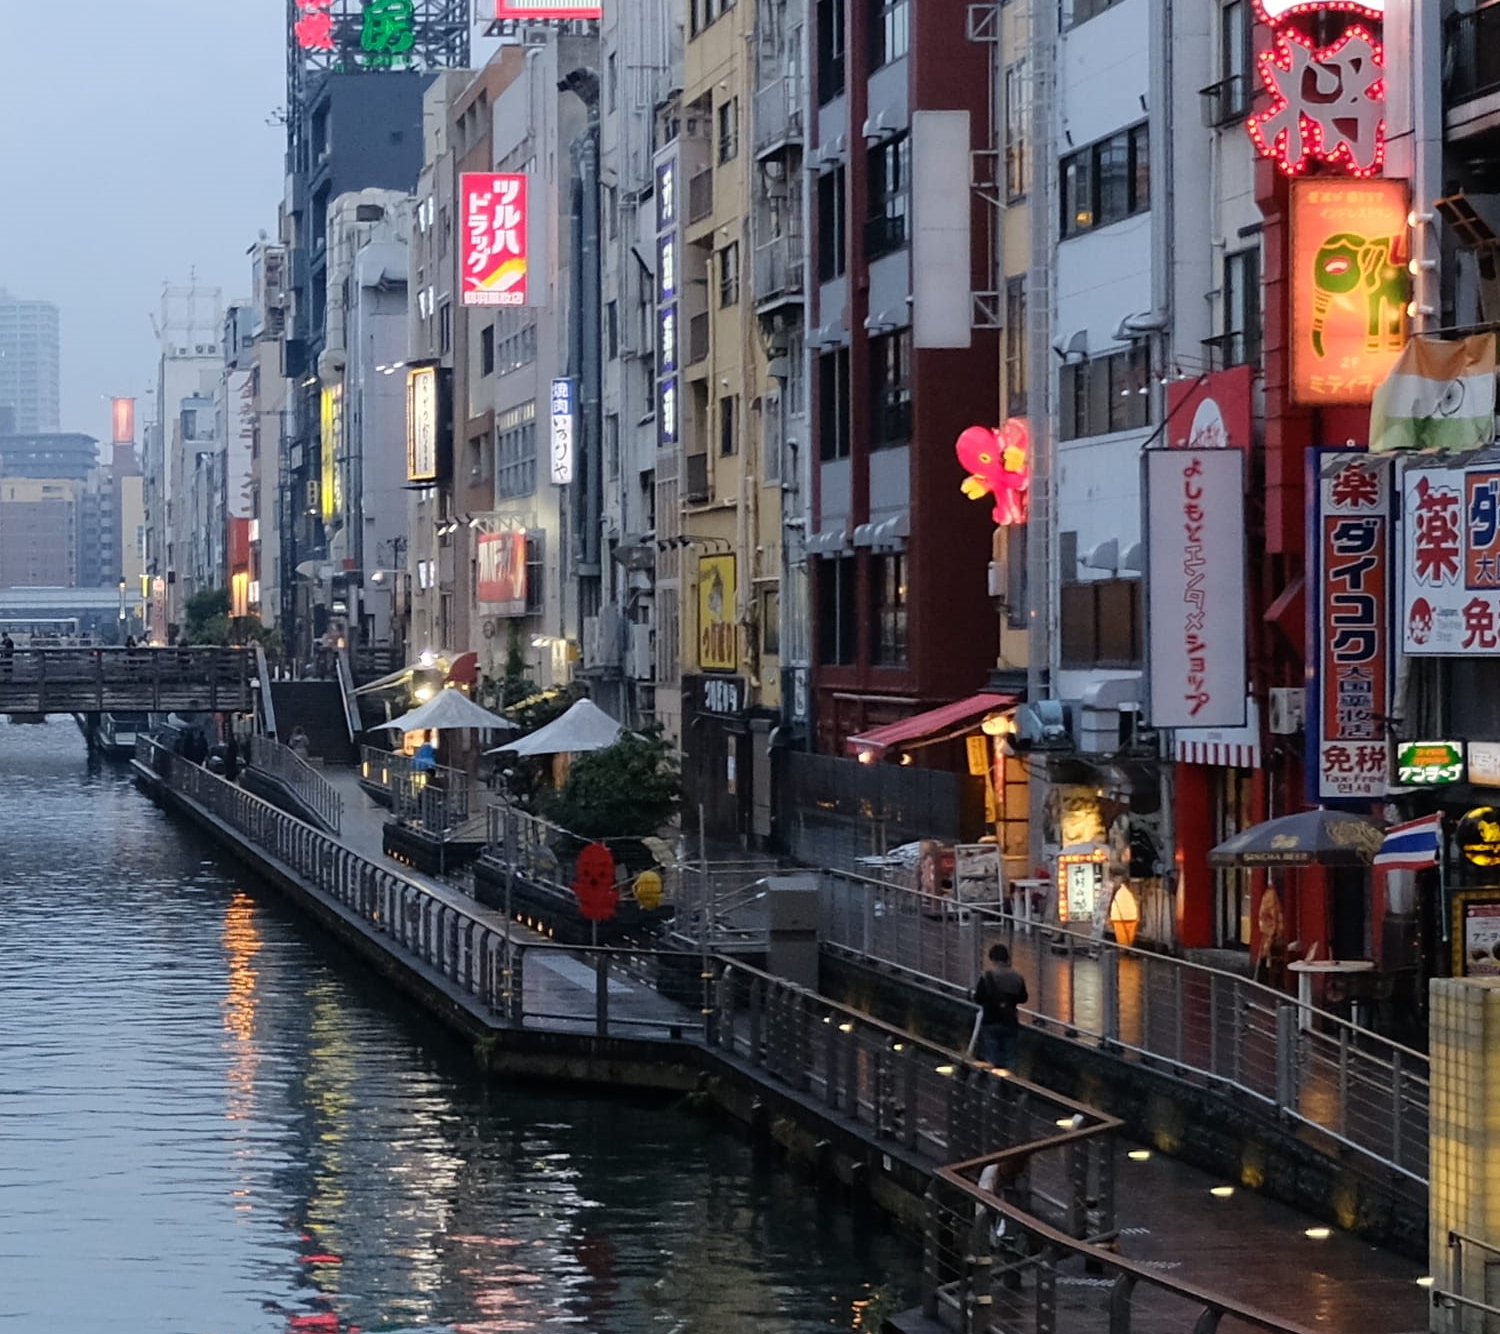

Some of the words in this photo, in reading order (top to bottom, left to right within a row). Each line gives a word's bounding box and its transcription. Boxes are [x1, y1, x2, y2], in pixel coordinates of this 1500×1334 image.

[467, 193, 493, 275] ドラッグ
[492, 179, 521, 256] ツルハ
[1415, 475, 1462, 585] 薬
[1181, 459, 1213, 716] よしもとエンタメショップ
[1330, 519, 1378, 663] ダイコク
[1323, 744, 1387, 775] 免税
